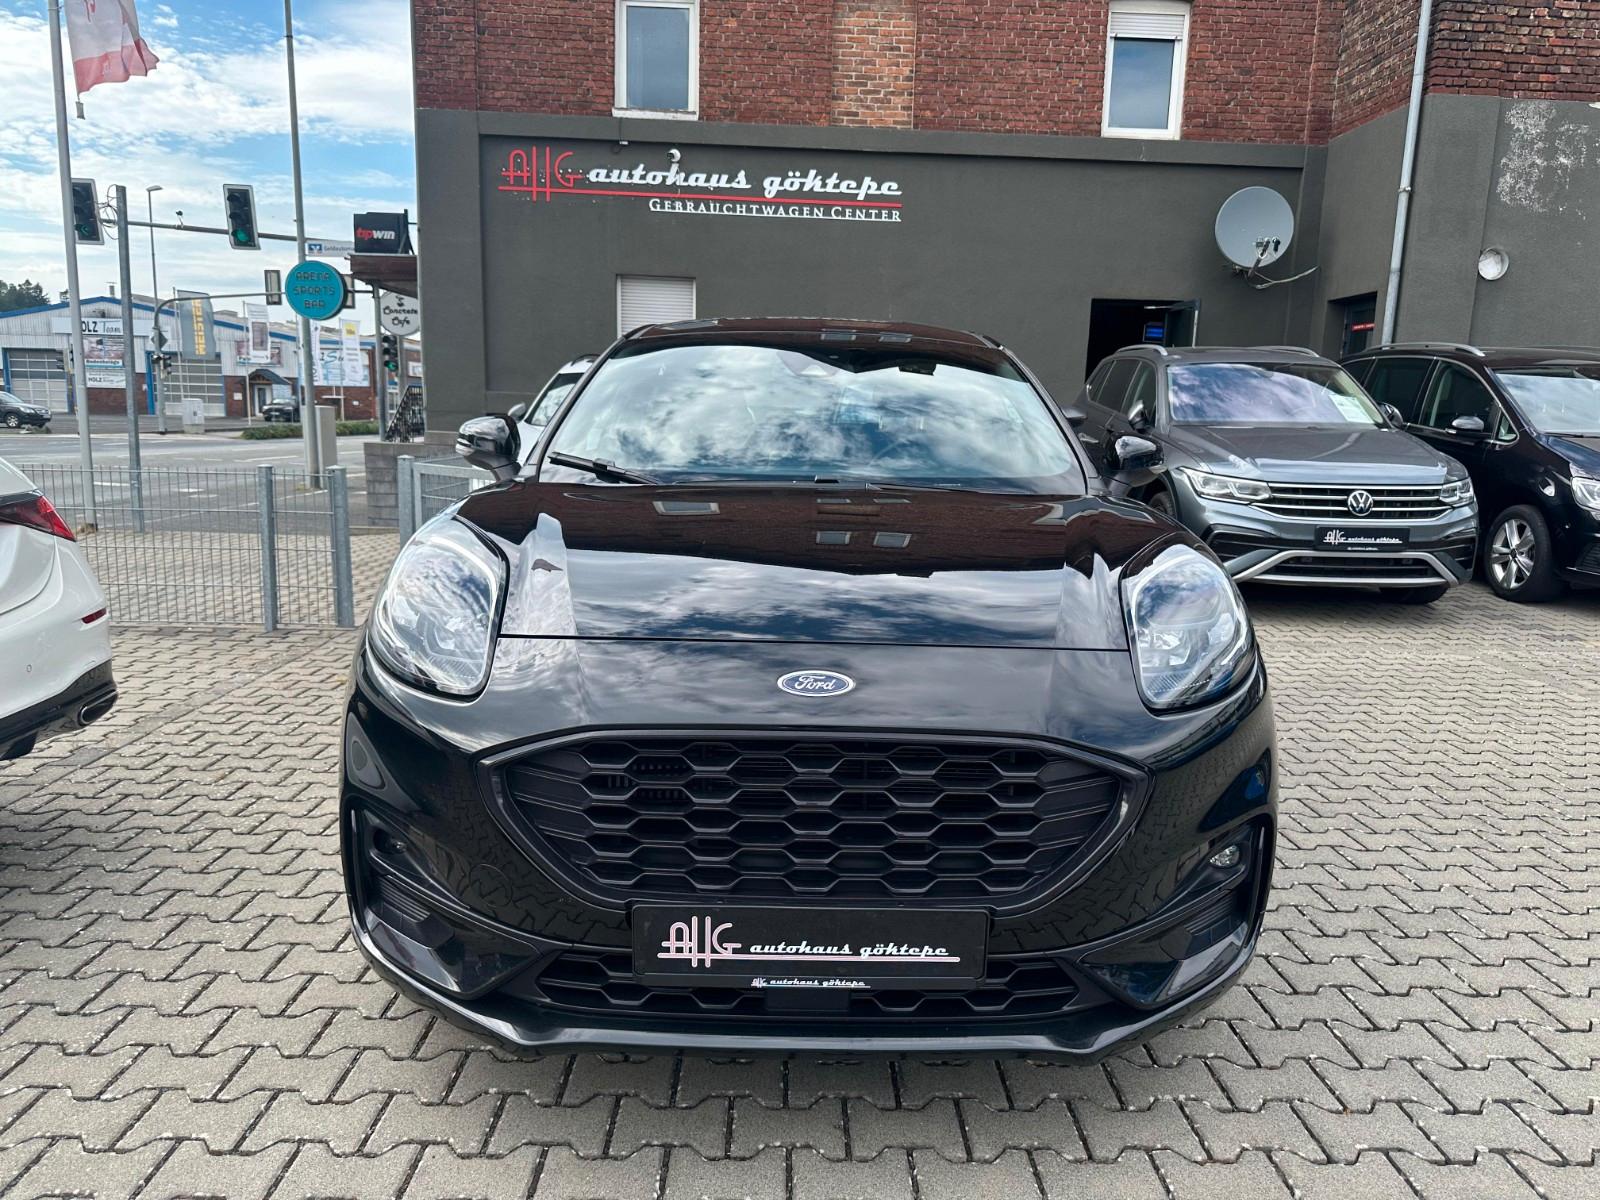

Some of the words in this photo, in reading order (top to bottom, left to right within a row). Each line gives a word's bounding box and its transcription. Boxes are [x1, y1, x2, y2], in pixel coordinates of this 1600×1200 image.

[588, 163, 752, 189] autohaus
[763, 169, 902, 200] göktepe
[649, 199, 824, 218] GEBRAUCHTWAGEN
[831, 206, 901, 222] CENTER
[296, 271, 330, 281] ARENA
[293, 286, 335, 295] SPORTS
[304, 299, 326, 309] BAR
[80, 320, 98, 333] OLZ
[794, 675, 837, 690] Ford
[750, 941, 853, 955] autohaus
[859, 941, 950, 959] göktepe
[769, 978, 820, 986] autohaus
